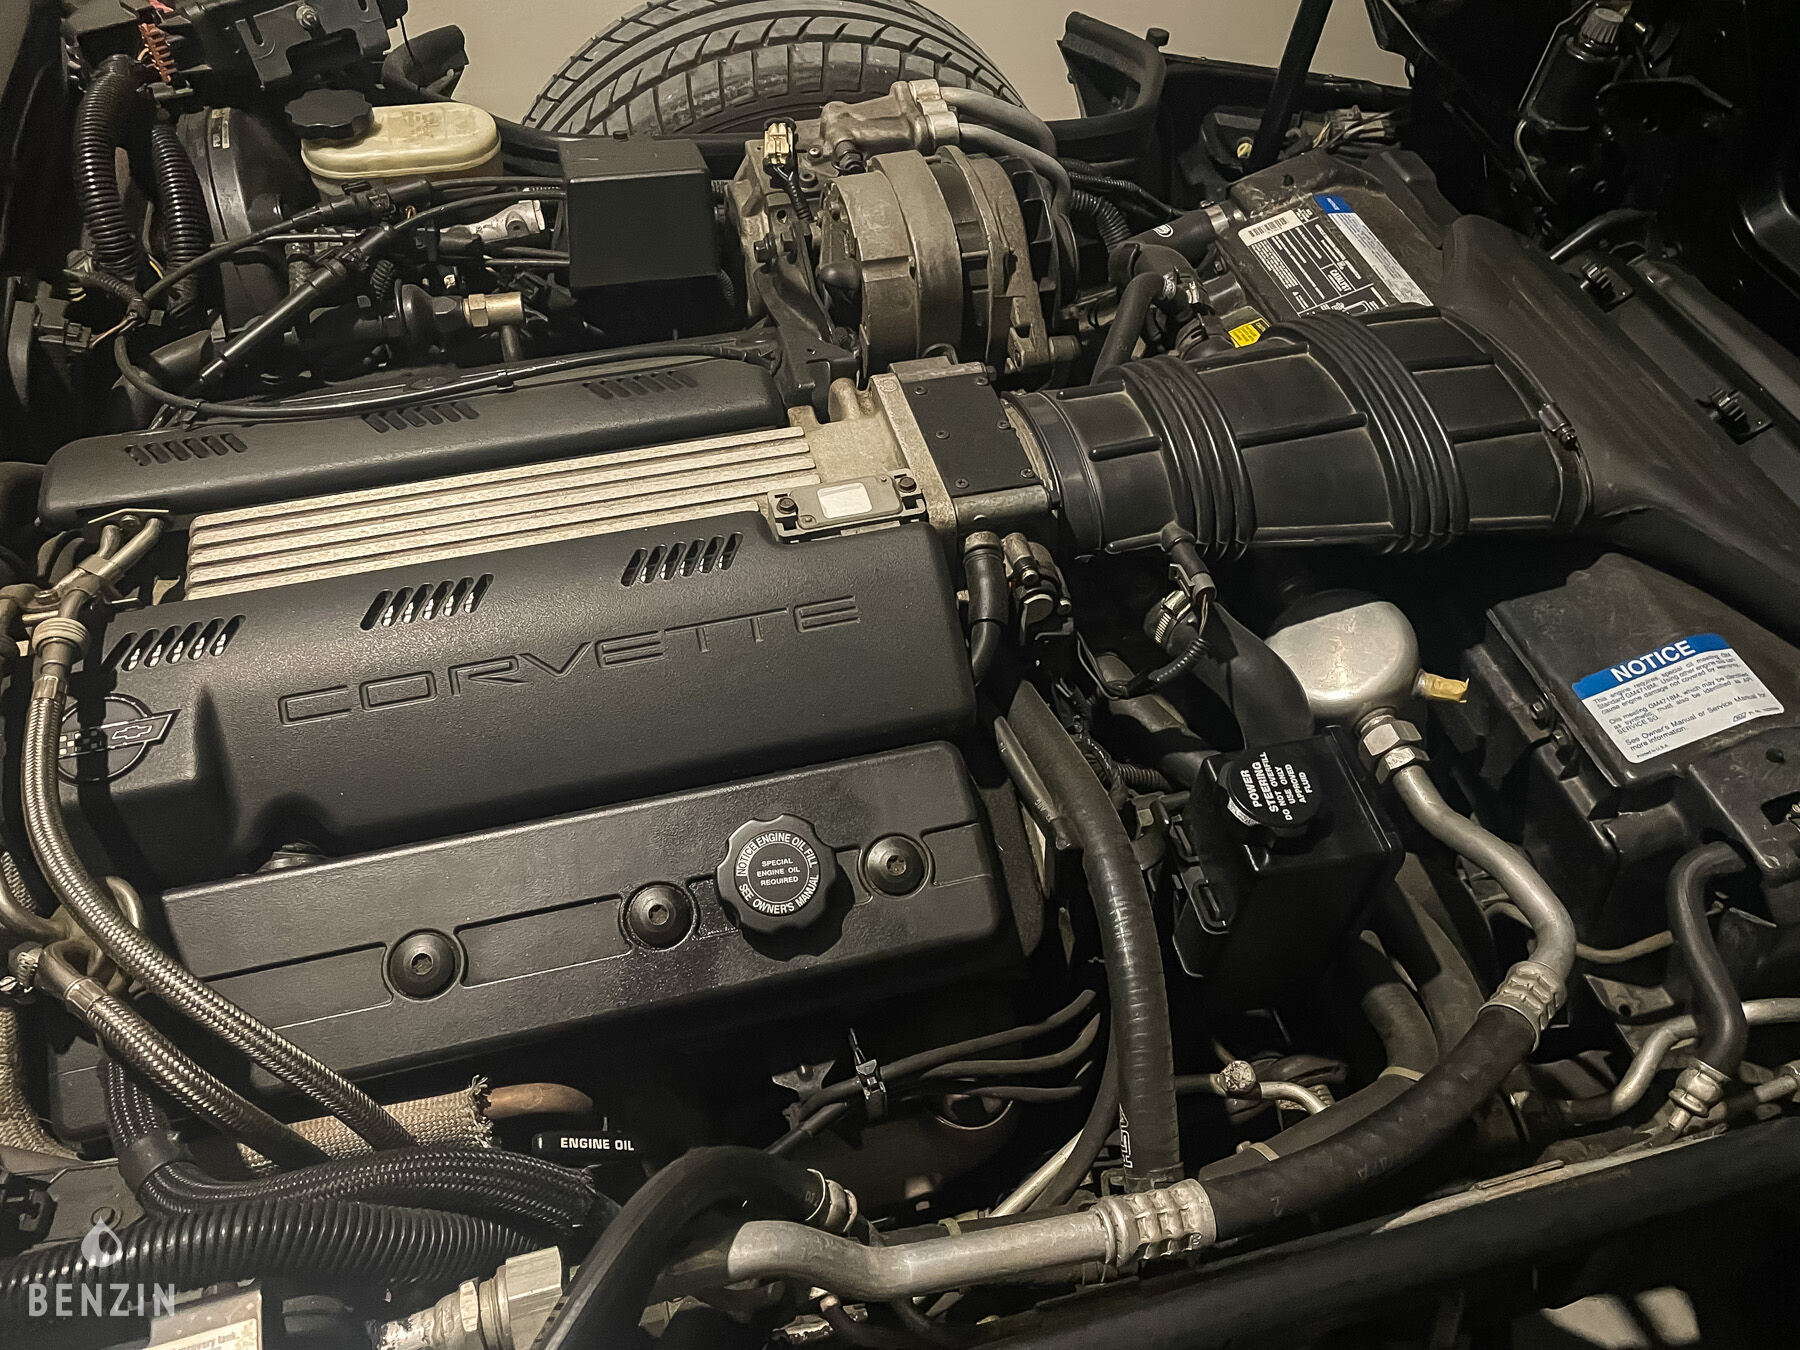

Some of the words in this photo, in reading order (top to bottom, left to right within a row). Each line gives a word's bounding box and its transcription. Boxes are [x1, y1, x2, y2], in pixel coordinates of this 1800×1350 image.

[278, 595, 861, 726] CORVETTE
[1610, 640, 1695, 682] NOTICE
[1260, 752, 1278, 787] OVERFILL
[1274, 766, 1288, 785] ONLY
[1240, 770, 1263, 808] POWER
[1252, 761, 1279, 812] STEERING
[1285, 764, 1307, 803] APPROVED
[1298, 772, 1313, 794] FLUID
[1274, 790, 1287, 807] NOT
[1284, 789, 1296, 804] USE
[1282, 809, 1293, 820] DO
[737, 842, 758, 876] NOTICE
[756, 833, 791, 848] ENGINE
[791, 838, 805, 852] OIL
[804, 850, 818, 868] FILL
[761, 858, 793, 868] SPECIAL
[756, 868, 785, 878] ENGINE
[787, 866, 801, 874] OIL
[760, 876, 799, 887] REQUIRED
[739, 883, 754, 901] SEE
[752, 898, 795, 914] OWNER'S
[795, 874, 819, 907] MANUAL
[560, 1138, 610, 1150] ENGINE
[614, 1139, 635, 1151] OIL
